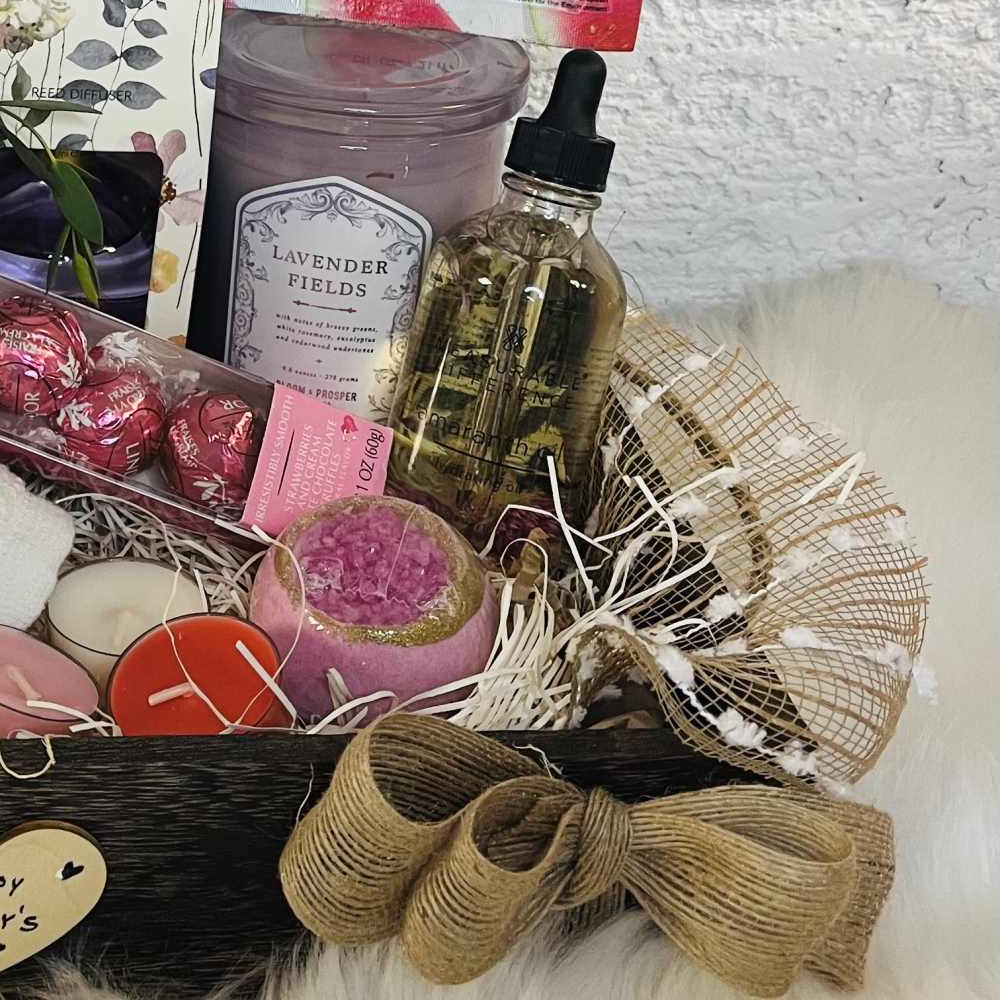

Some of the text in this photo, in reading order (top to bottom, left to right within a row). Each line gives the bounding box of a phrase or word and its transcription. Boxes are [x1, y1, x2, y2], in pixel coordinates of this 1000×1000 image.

[31, 87, 132, 101] REED DIFFUSER
[272, 245, 388, 275] LAVENDER
[288, 273, 367, 298] FIELDS
[276, 313, 290, 321] with
[294, 317, 312, 326] notes
[276, 324, 295, 333] white
[337, 335, 376, 344] eucalyptus
[291, 338, 331, 350] cedarwood
[315, 388, 357, 402] PROSPER
[416, 402, 533, 457] amaranth
[310, 418, 338, 495] CHOCOLATE
[362, 427, 386, 460] (60g)
[254, 394, 296, 523] IRRESISTIBLY SMOOTH
[283, 423, 315, 512] STRAWBERRIES
[303, 435, 323, 480] CREAM
[357, 459, 375, 482] OZ
